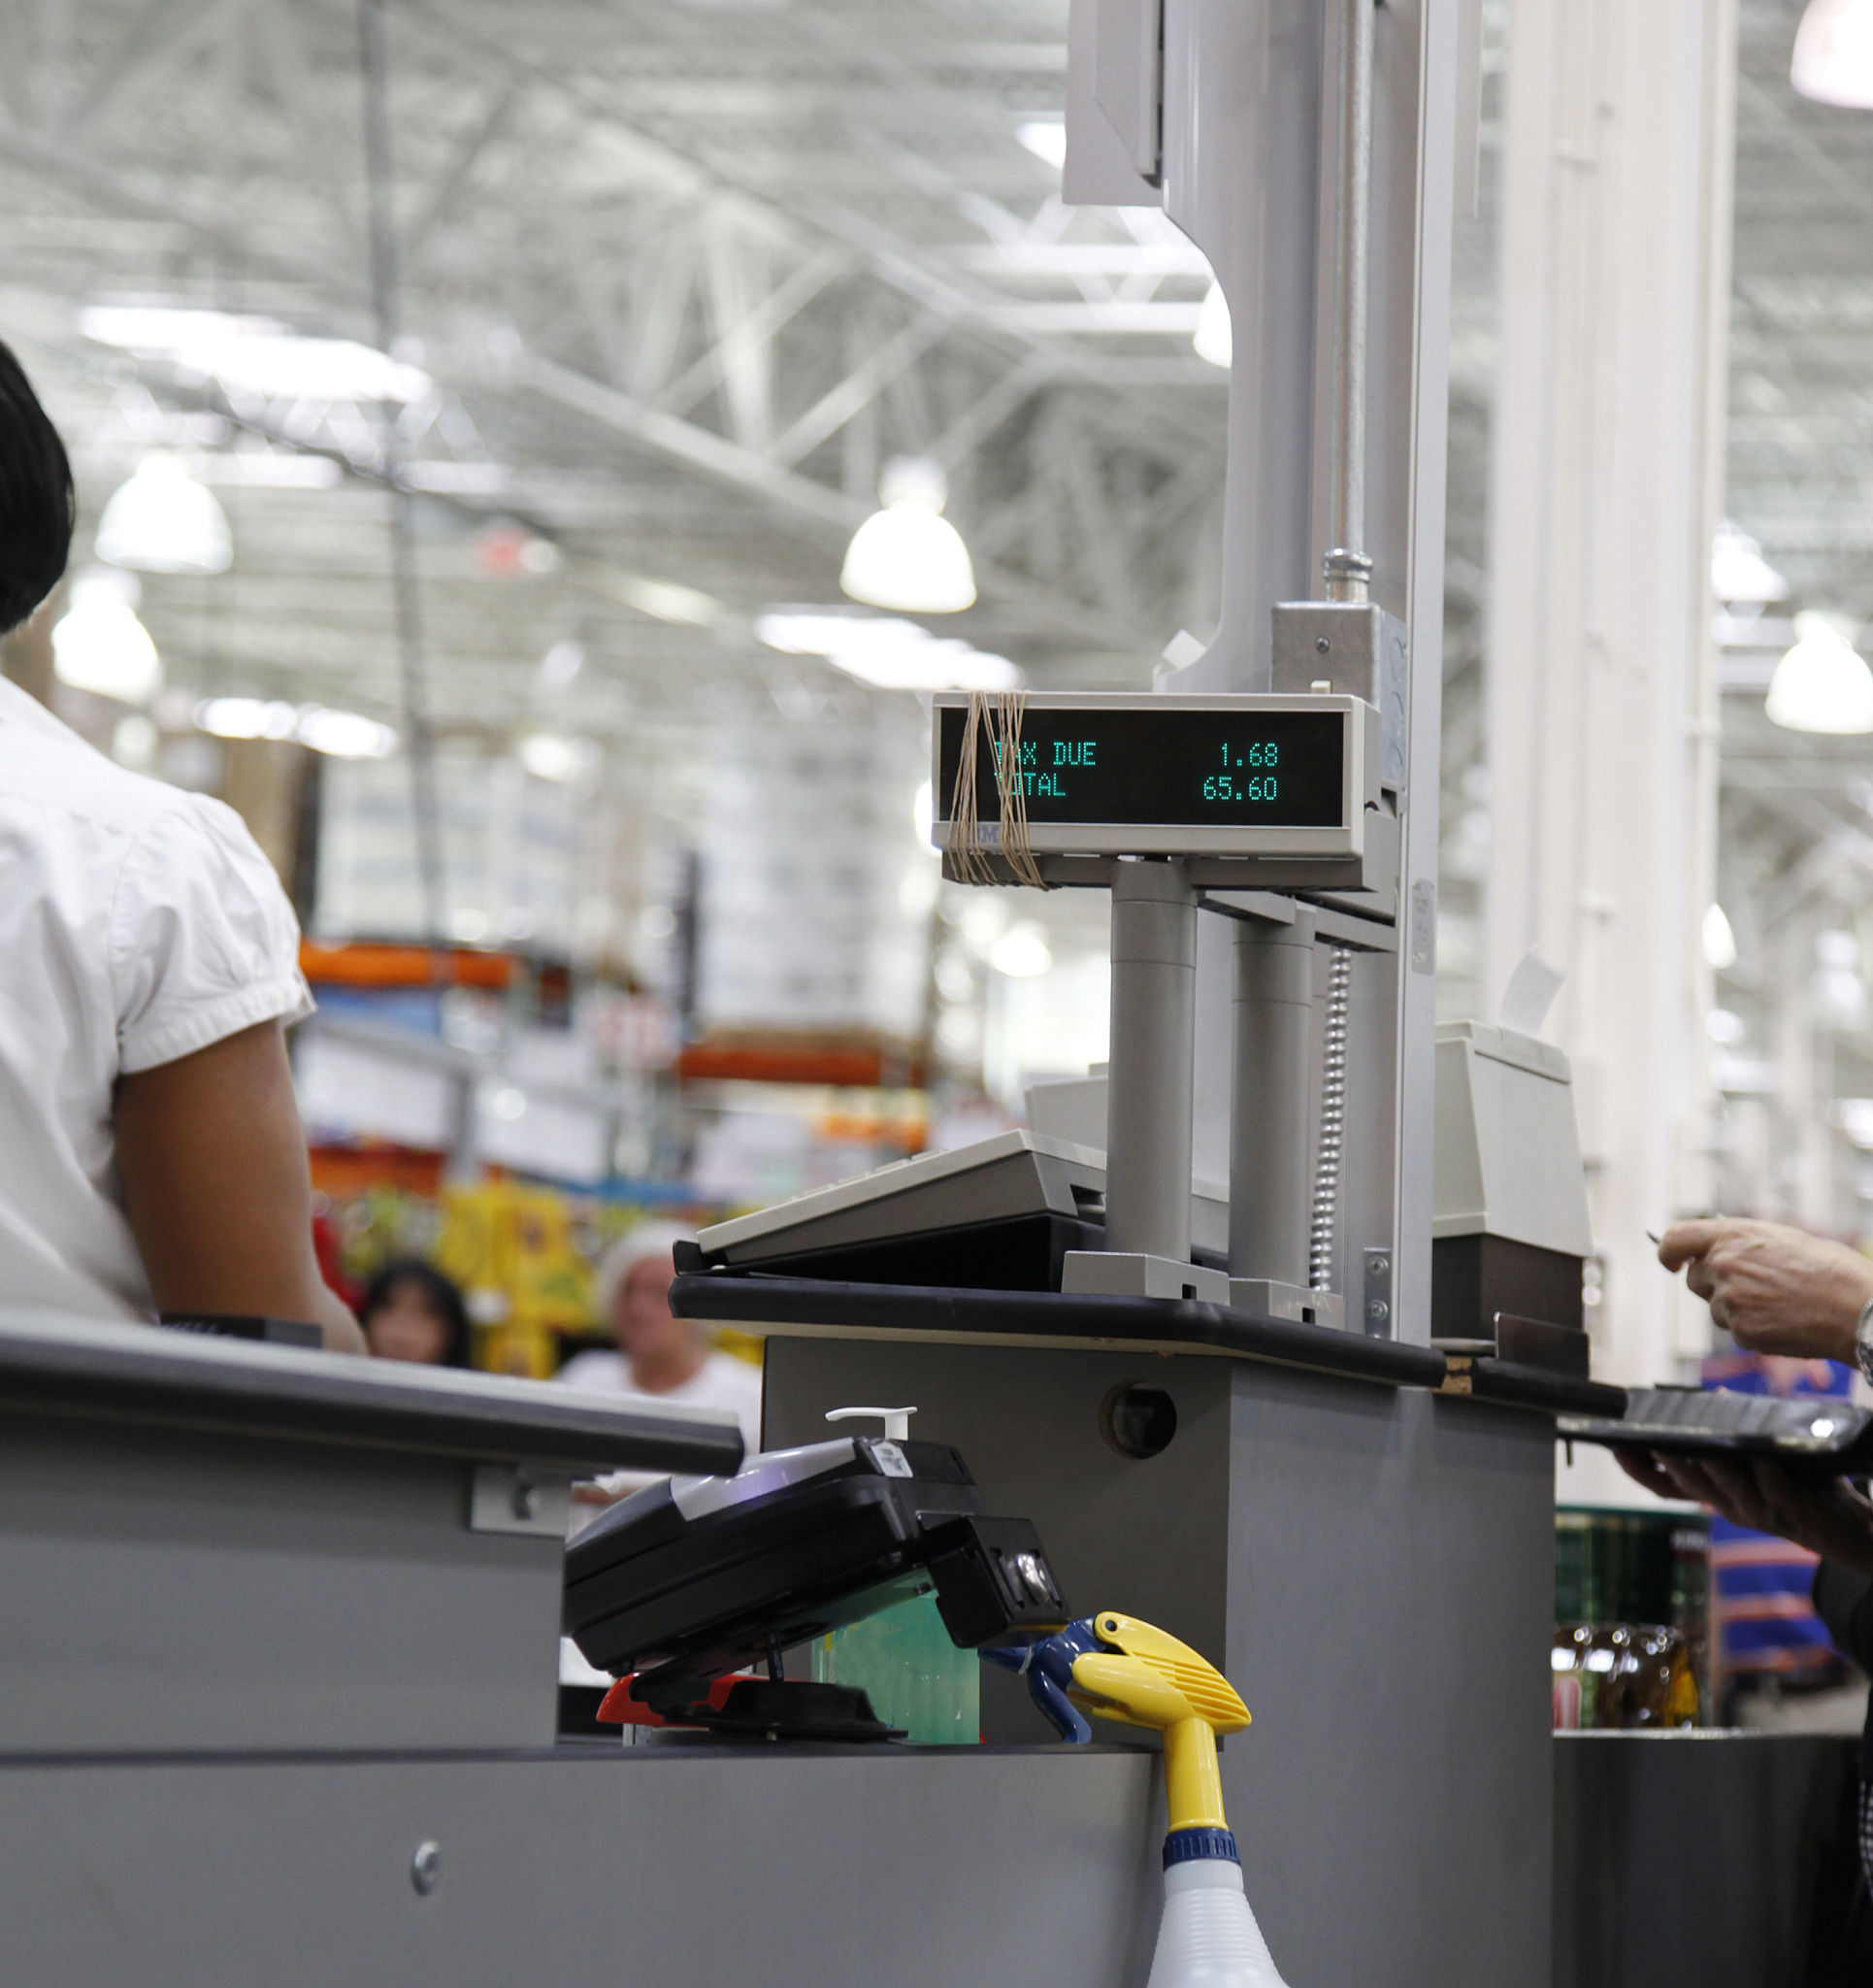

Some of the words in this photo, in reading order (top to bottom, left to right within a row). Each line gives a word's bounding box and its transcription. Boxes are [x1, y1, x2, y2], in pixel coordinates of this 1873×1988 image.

[1053, 741, 1097, 766] DUE
[1221, 742, 1278, 767] 1.68
[1203, 776, 1277, 801] 65.60
